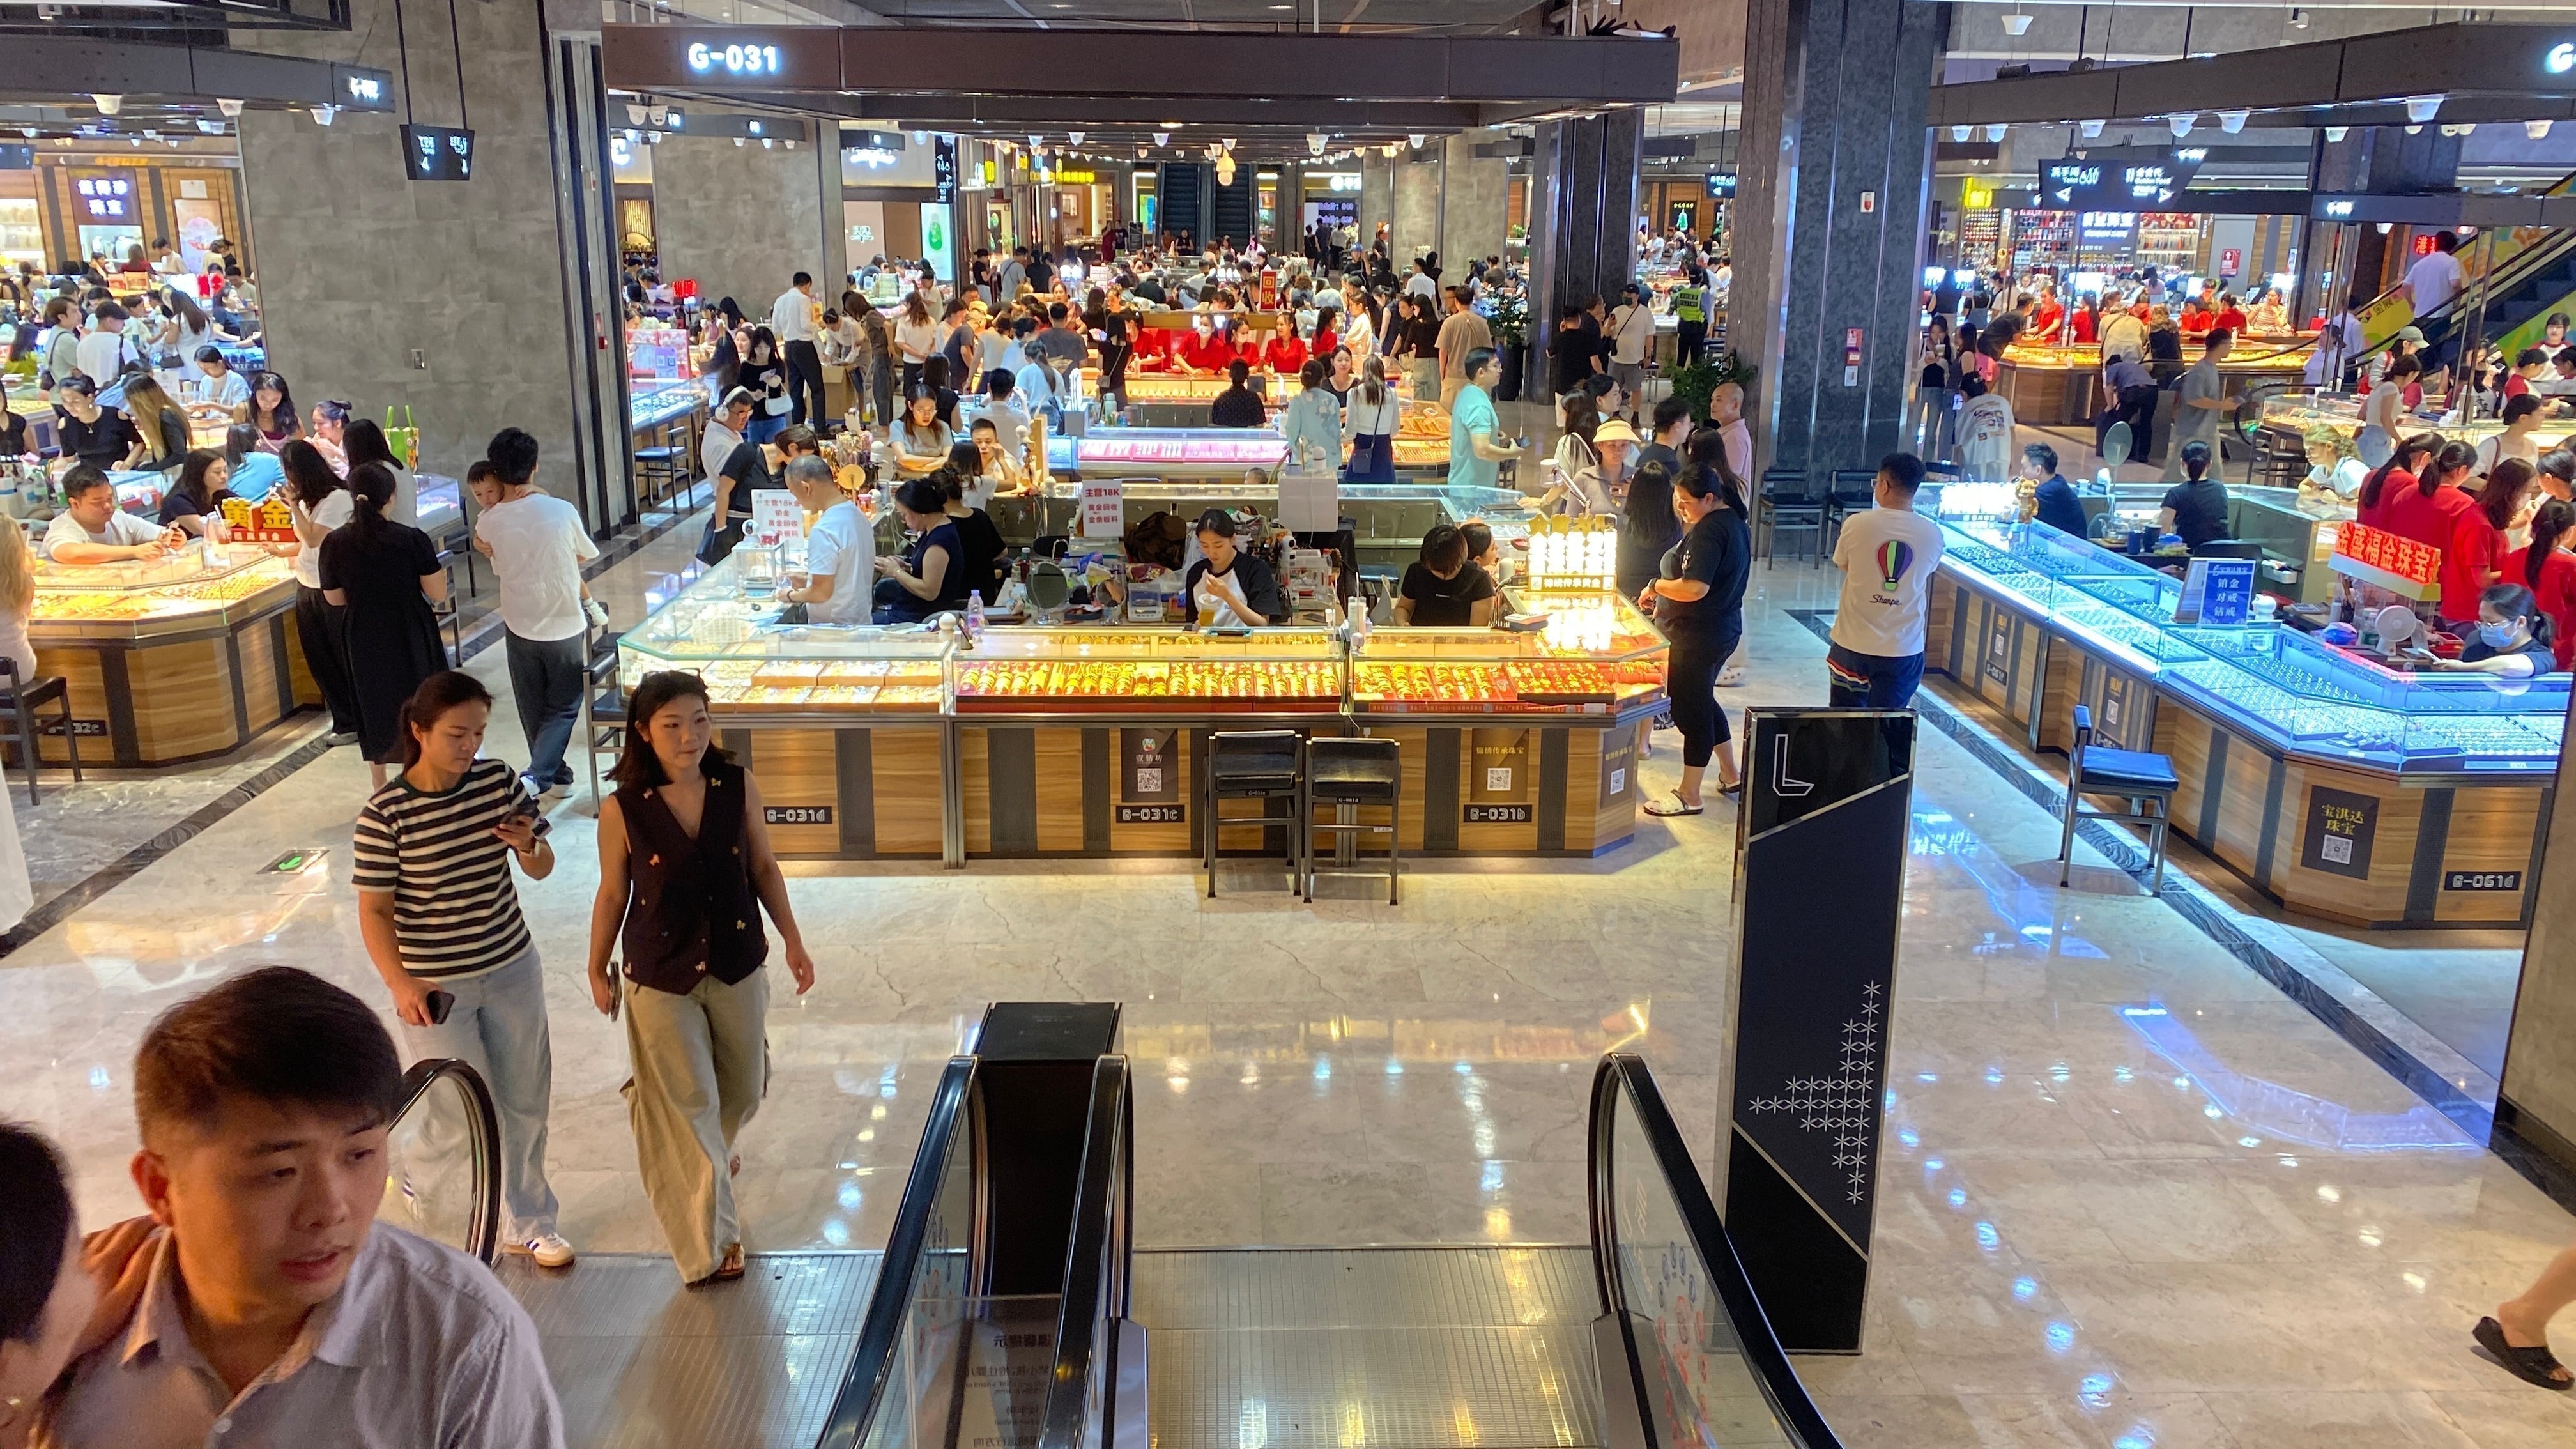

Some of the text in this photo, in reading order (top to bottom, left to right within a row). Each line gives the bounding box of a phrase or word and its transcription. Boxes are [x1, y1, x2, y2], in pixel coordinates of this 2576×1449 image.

[688, 42, 777, 72] G-031
[1262, 276, 1275, 305] 回收
[1085, 488, 1119, 497] 主营18K
[222, 498, 293, 531] 黄金
[2218, 578, 2239, 588] 铂金
[2216, 592, 2237, 603] 对戒
[2214, 606, 2236, 617] 钻戒
[767, 809, 825, 822] G-031d
[1122, 808, 1178, 821] G-031c
[1470, 808, 1526, 821] G-031b
[2321, 803, 2365, 824] 宝淇达
[2326, 819, 2356, 836] 珠宝
